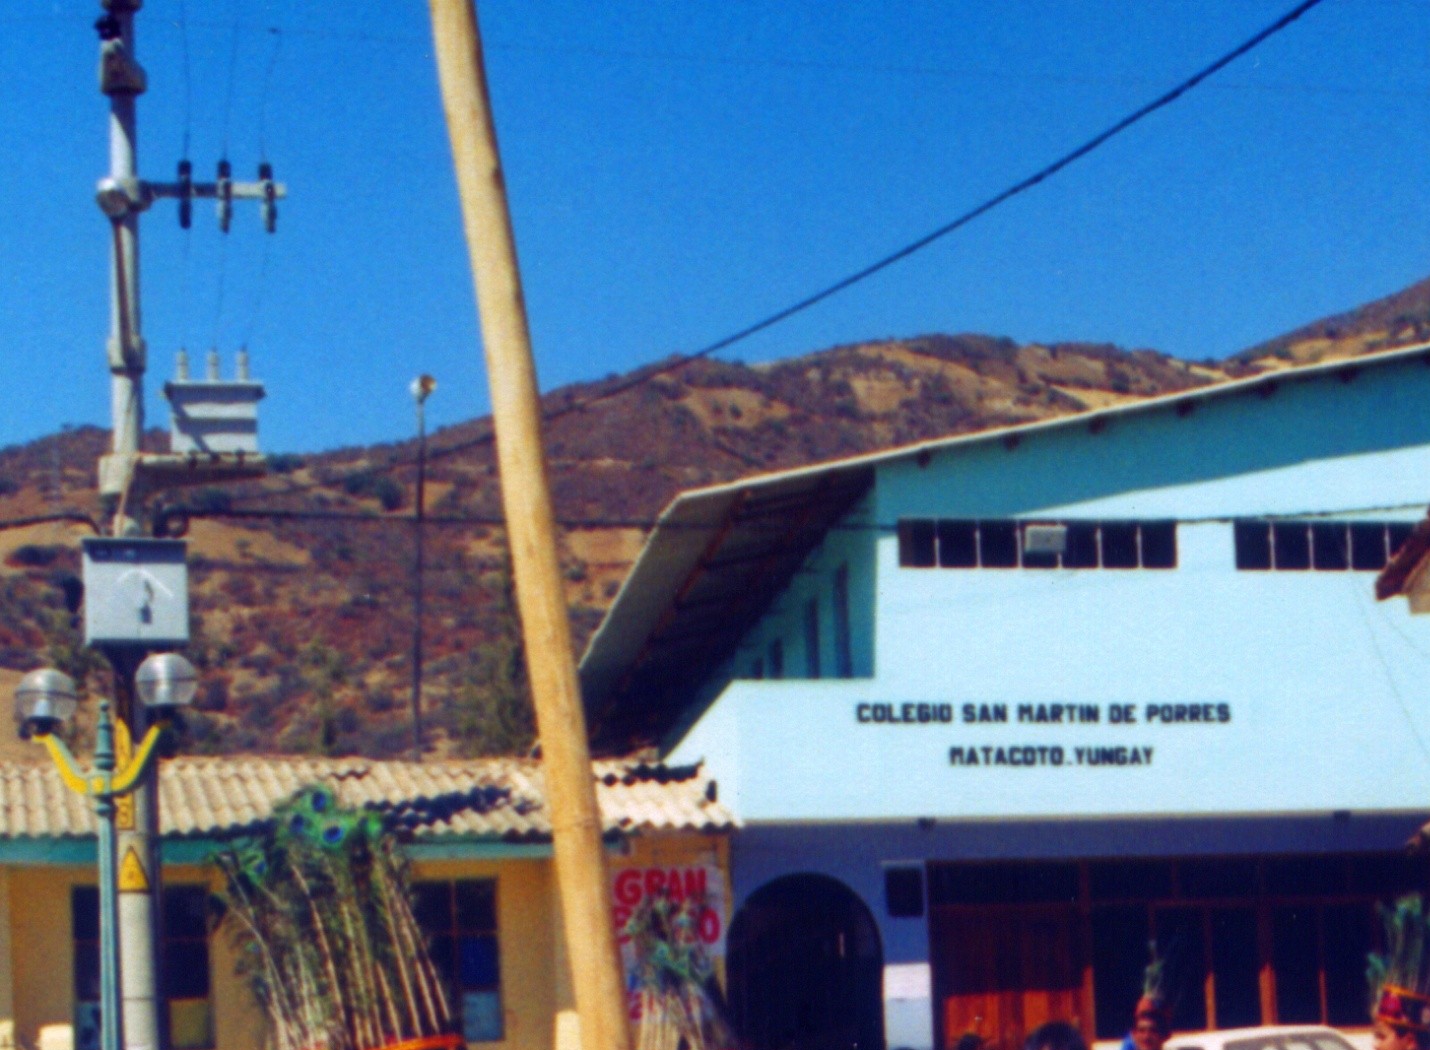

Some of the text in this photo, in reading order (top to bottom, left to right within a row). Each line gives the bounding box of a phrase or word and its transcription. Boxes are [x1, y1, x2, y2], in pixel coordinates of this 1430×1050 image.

[857, 703, 1230, 723] COLEGIO SAN MARTIN DE PORRES
